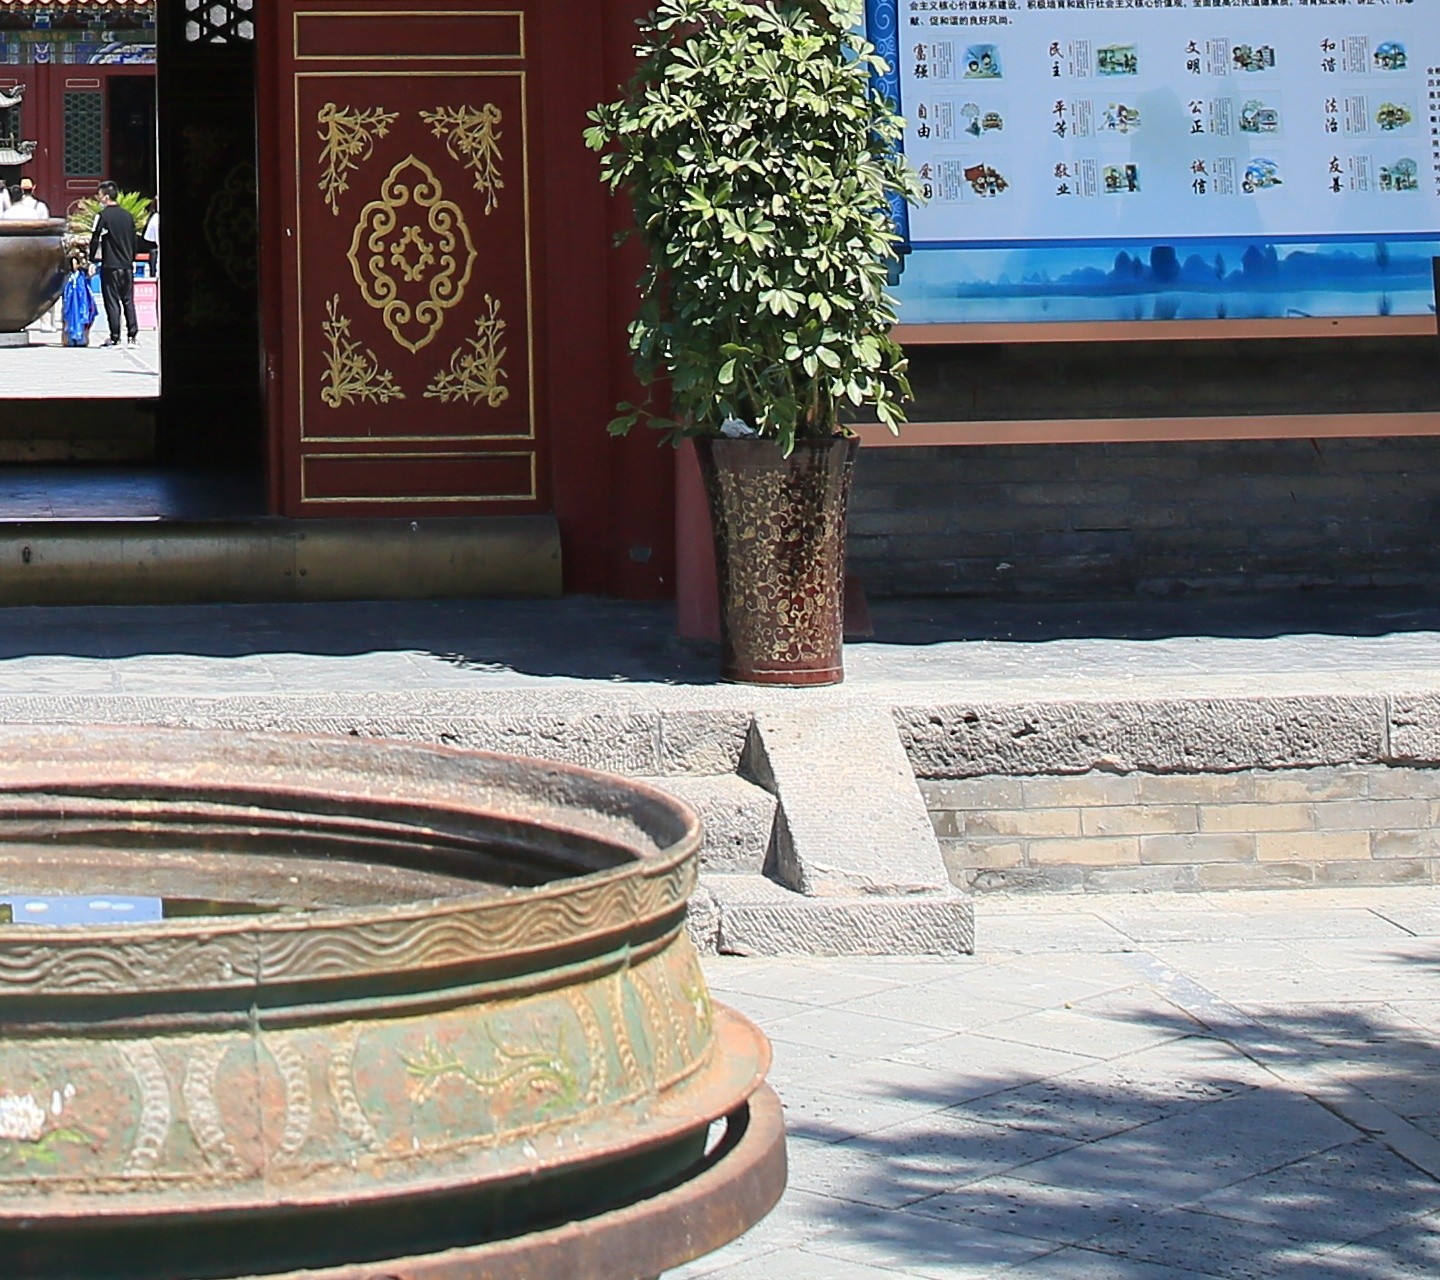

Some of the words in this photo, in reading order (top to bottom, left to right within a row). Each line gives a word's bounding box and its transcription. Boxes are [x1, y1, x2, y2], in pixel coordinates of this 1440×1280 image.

[909, 15, 1015, 26] 献、促和谐的良好风尚。
[913, 42, 930, 79] 富强
[1048, 40, 1064, 78] 民主
[1184, 39, 1202, 75] 文明
[1320, 37, 1337, 74] 和谐
[917, 102, 931, 139] 自由
[1052, 100, 1068, 139] 平等
[1188, 100, 1206, 135] 公正
[1324, 98, 1339, 134] 法治
[1054, 162, 1072, 197] 敬业
[1190, 159, 1208, 195] 诚信
[1328, 156, 1345, 194] 友善
